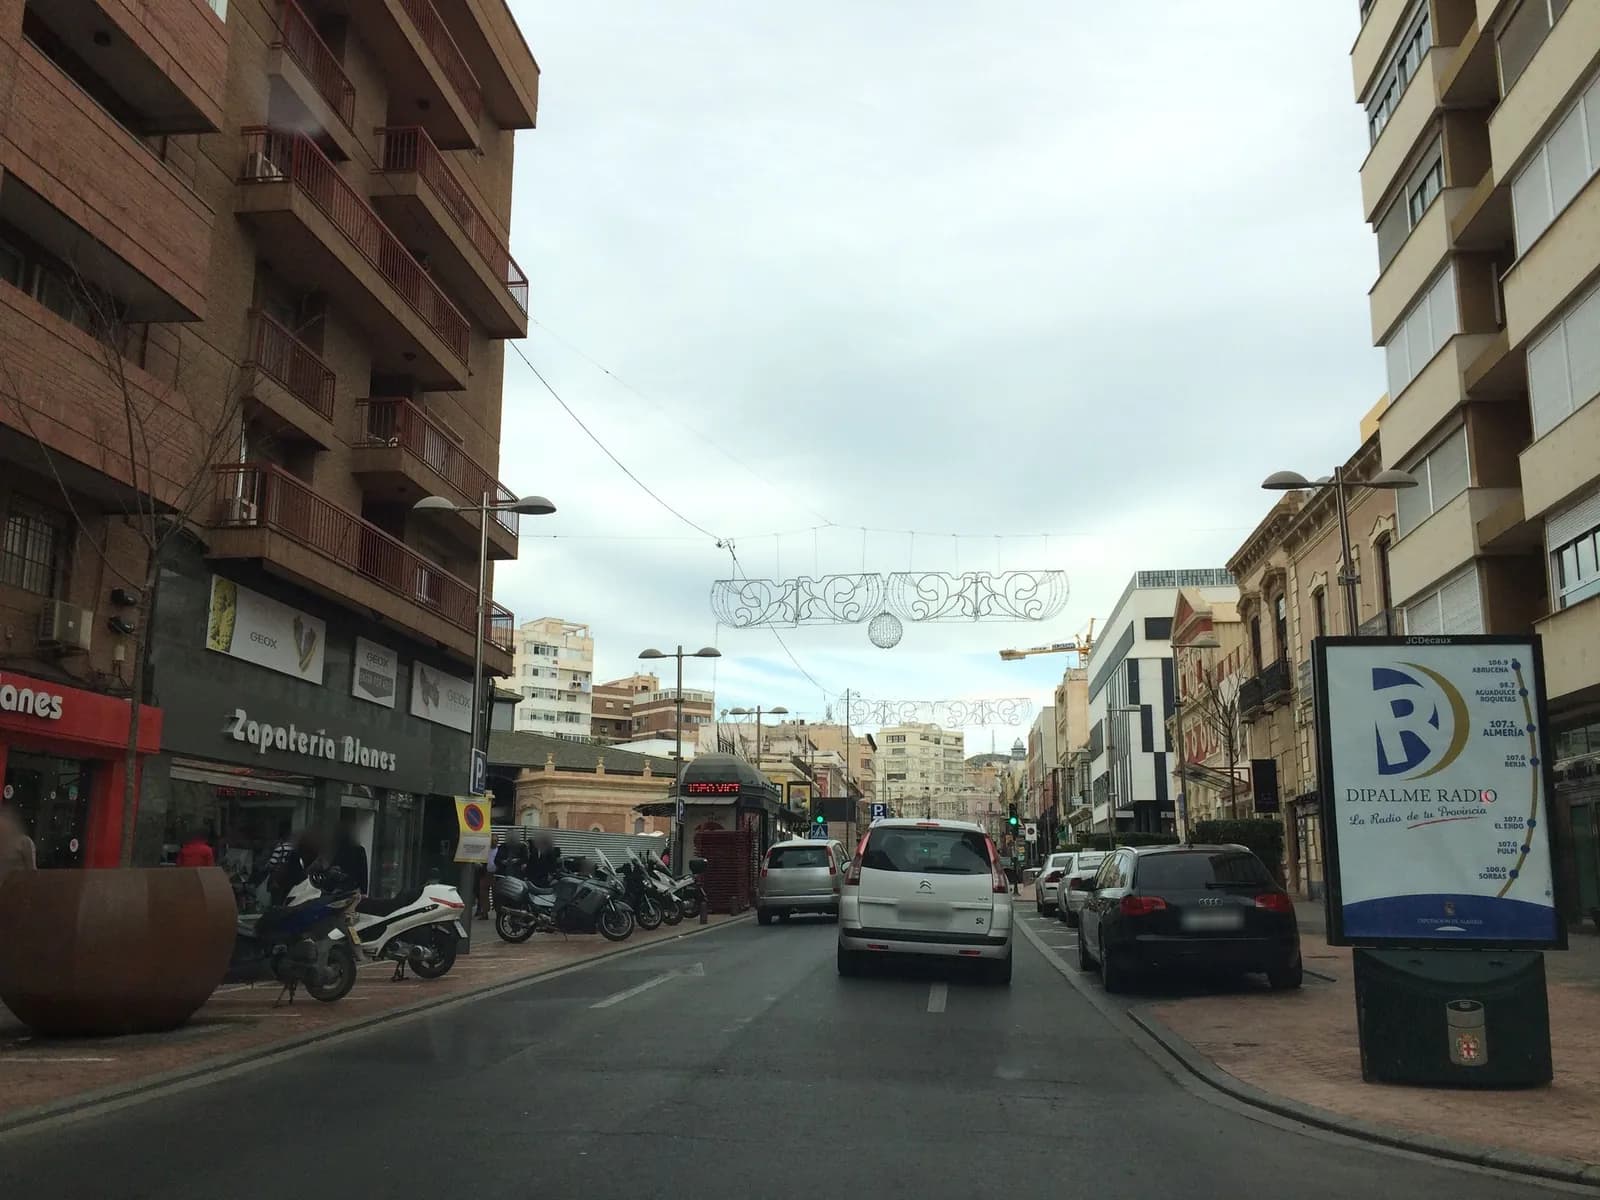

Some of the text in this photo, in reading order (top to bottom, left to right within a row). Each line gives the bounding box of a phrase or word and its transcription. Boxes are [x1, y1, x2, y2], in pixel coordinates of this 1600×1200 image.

[250, 632, 277, 649] GEOX
[1406, 636, 1451, 644] JCDecaux
[366, 652, 389, 667] GEOX
[0, 684, 63, 720] anes
[1483, 728, 1524, 736] ALMERÍA
[343, 736, 396, 772] Blanes
[476, 757, 483, 789] P
[1347, 789, 1498, 802] DIPALME RADIO
[1350, 814, 1365, 825] La
[1370, 813, 1401, 824] Radio
[1407, 811, 1419, 820] de
[1438, 806, 1487, 817] Provincia
